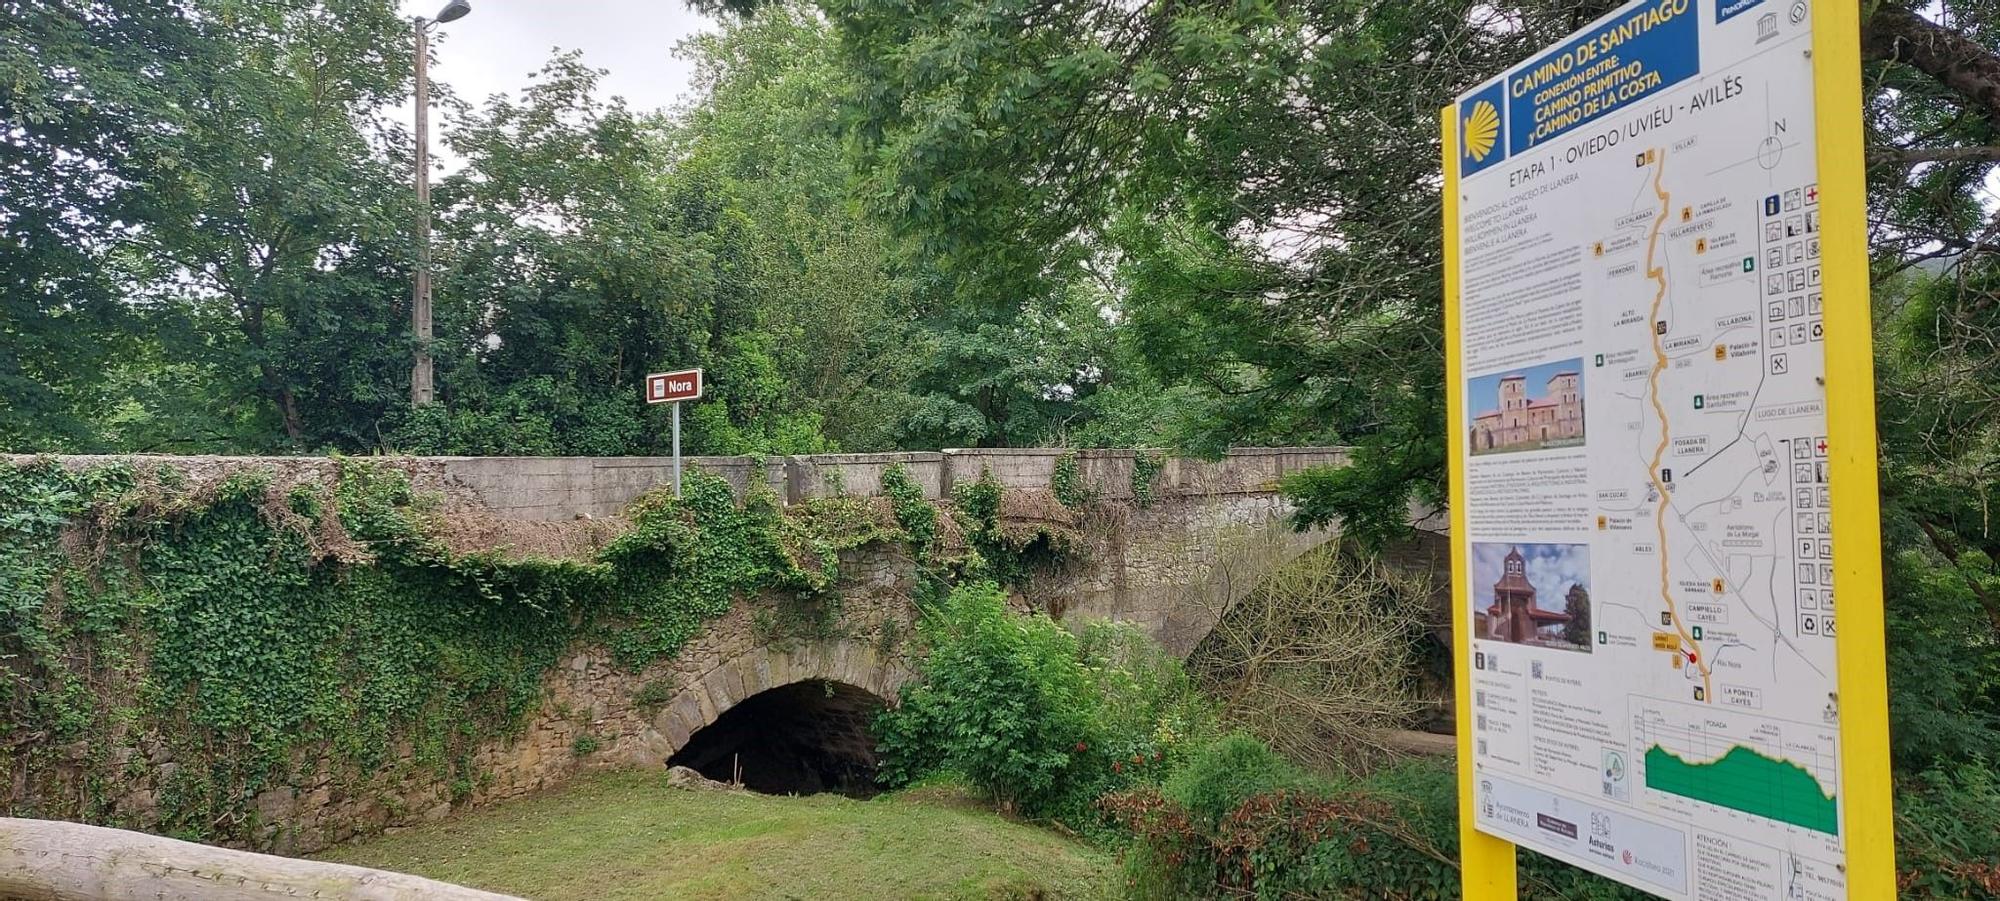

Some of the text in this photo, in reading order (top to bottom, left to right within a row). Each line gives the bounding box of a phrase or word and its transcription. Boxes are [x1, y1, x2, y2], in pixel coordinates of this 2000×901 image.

[1513, 0, 1688, 97] CAMINO DE SANTIAGO
[1535, 56, 1619, 105] CONEXIÓN ENTRE:
[1535, 61, 1642, 123] CAMINO PRIMITIVO
[1528, 70, 1661, 146] y CAMINO DE LA COSTA
[1510, 161, 1545, 188] ETAPA
[1566, 129, 1619, 164] OVIEDO
[1629, 105, 1673, 138] UVIÉU
[1690, 75, 1743, 115] AVILÉS
[1775, 118, 1786, 136] N
[1510, 188, 1539, 206] CONCEJO
[1541, 185, 1548, 194] DE
[1550, 172, 1579, 191] LLANERA
[1502, 204, 1528, 219] LLANERA
[1511, 213, 1537, 229] LLANERA
[1617, 218, 1625, 227] LA
[1717, 315, 1752, 328] VILLABONA
[1665, 337, 1699, 350] LA MIRANDA
[669, 381, 692, 392] Nora
[1758, 404, 1821, 419] LUGO DE LLANERA
[1675, 438, 1697, 447] POSADA
[1677, 446, 1704, 454] LLANERA
[1689, 605, 1722, 614] CAMPIELLO
[1733, 689, 1754, 698] PONTE
[1706, 720, 1727, 729] POSADA
[1589, 835, 1615, 853] Asturias
